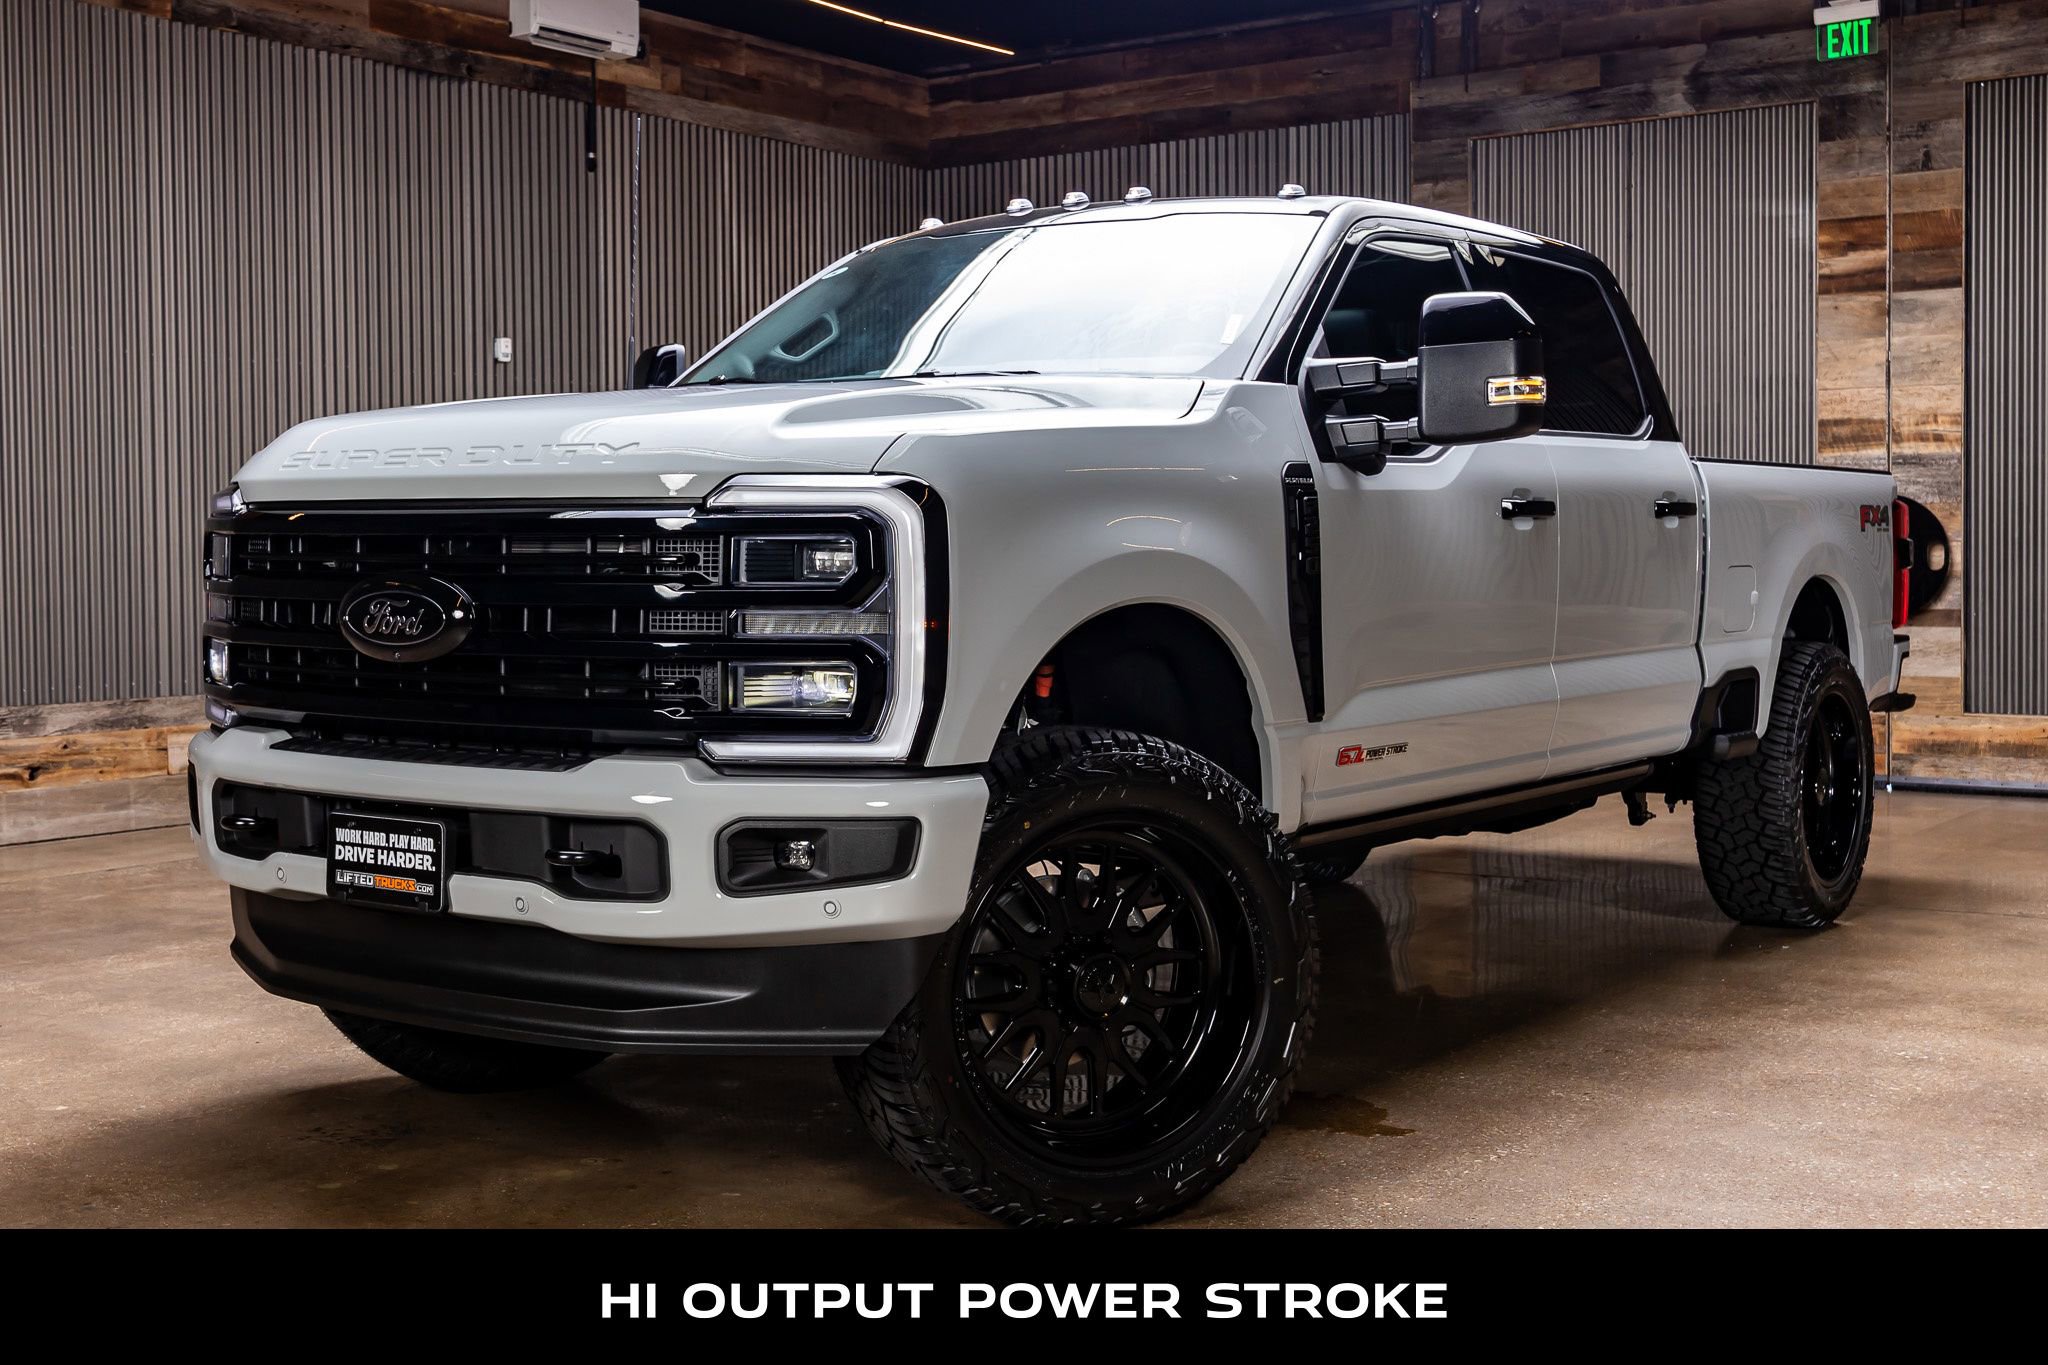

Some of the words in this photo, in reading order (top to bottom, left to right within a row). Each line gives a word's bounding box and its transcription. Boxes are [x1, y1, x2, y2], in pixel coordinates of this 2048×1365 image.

[1827, 19, 1871, 59] EXIT
[280, 448, 452, 471] SUPER
[459, 442, 640, 466] DUTY
[1860, 505, 1889, 532] FX4
[363, 599, 424, 635] Ford
[1365, 748, 1385, 758] POWER
[1385, 745, 1408, 755] STROKE
[336, 828, 362, 844] WORK
[362, 830, 388, 847] HARD.
[389, 833, 409, 849] PLAY
[410, 836, 436, 853] HARD.
[335, 844, 375, 864] DRIVE
[377, 849, 436, 872] HARDER.
